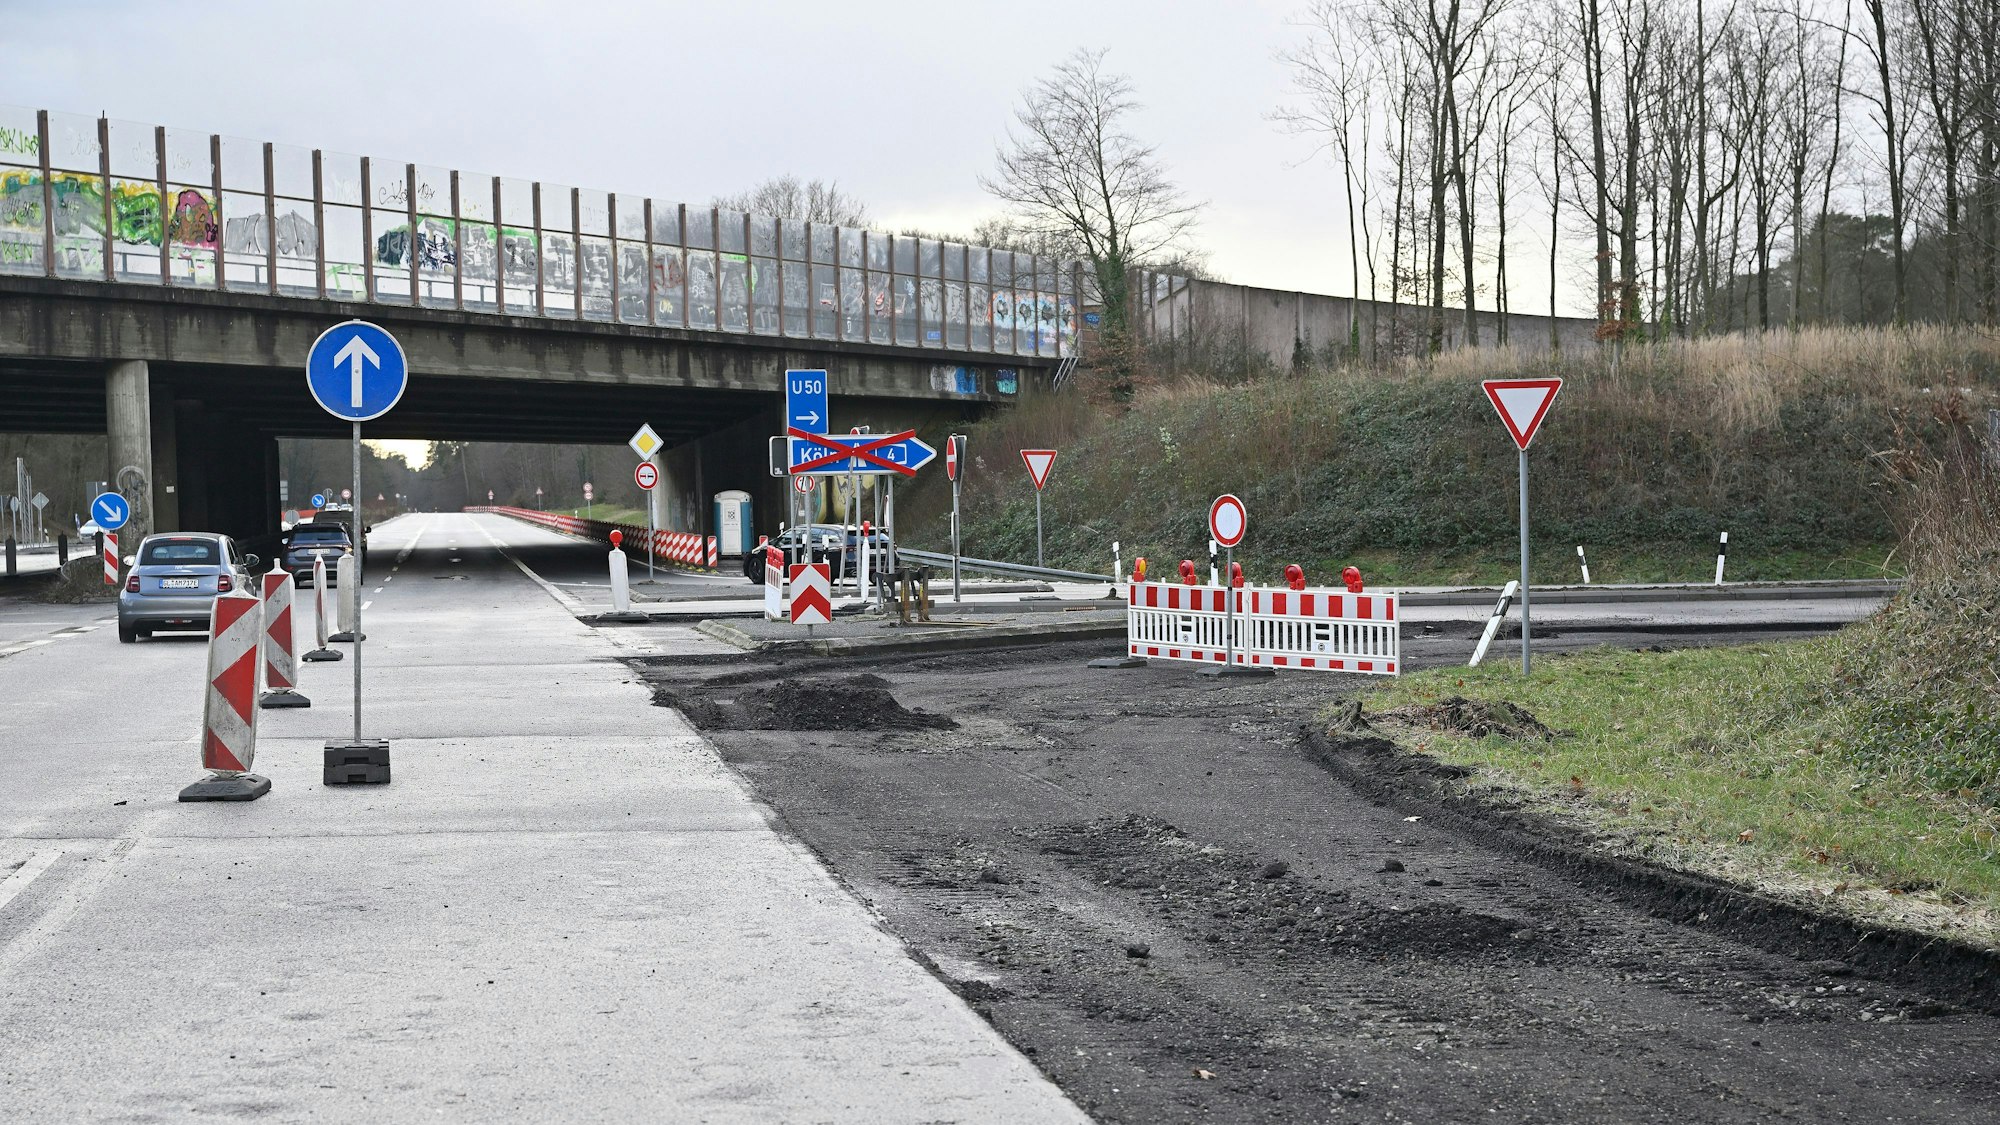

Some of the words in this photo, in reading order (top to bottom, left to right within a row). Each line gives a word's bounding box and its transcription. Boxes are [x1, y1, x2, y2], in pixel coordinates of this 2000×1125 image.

[1, 240, 33, 264] KEN
[792, 380, 803, 395] U
[804, 380, 821, 395] 50
[888, 449, 895, 461] 4
